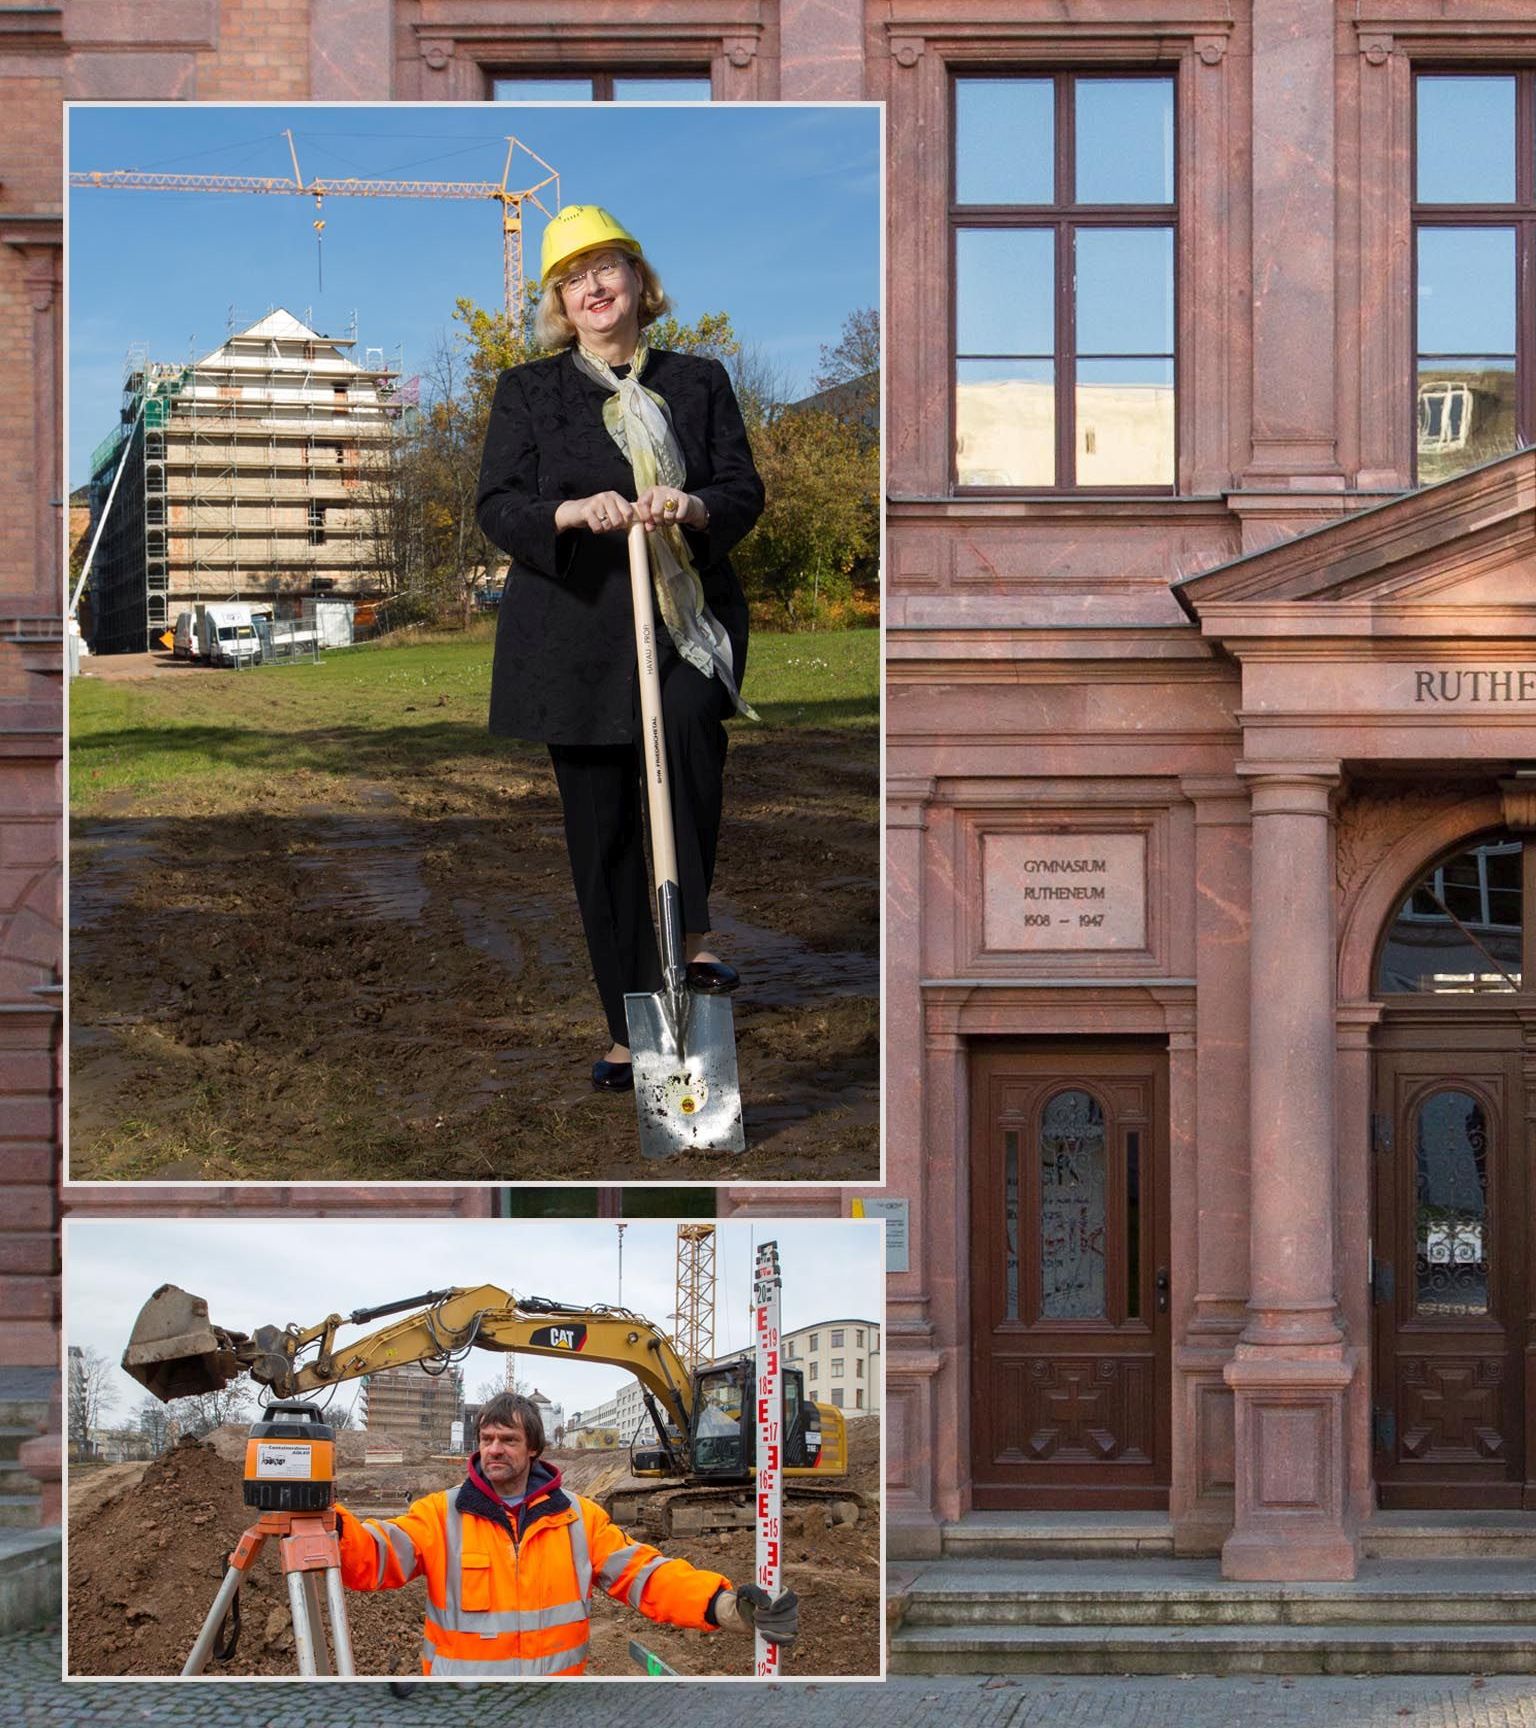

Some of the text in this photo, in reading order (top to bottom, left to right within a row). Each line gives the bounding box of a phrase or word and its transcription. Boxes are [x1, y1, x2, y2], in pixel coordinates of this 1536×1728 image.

[1023, 859, 1106, 873] GYMNASIUM
[1023, 886, 1106, 900] RUTHENEUM
[1023, 914, 1051, 927] 1608
[1078, 914, 1105, 928] 1947
[550, 1327, 574, 1349] CAT
[768, 1327, 778, 1347] 19
[759, 1375, 768, 1395] 18
[769, 1421, 779, 1441] 17
[759, 1469, 768, 1489] 16
[769, 1518, 779, 1538] 15
[759, 1565, 768, 1585] 14
